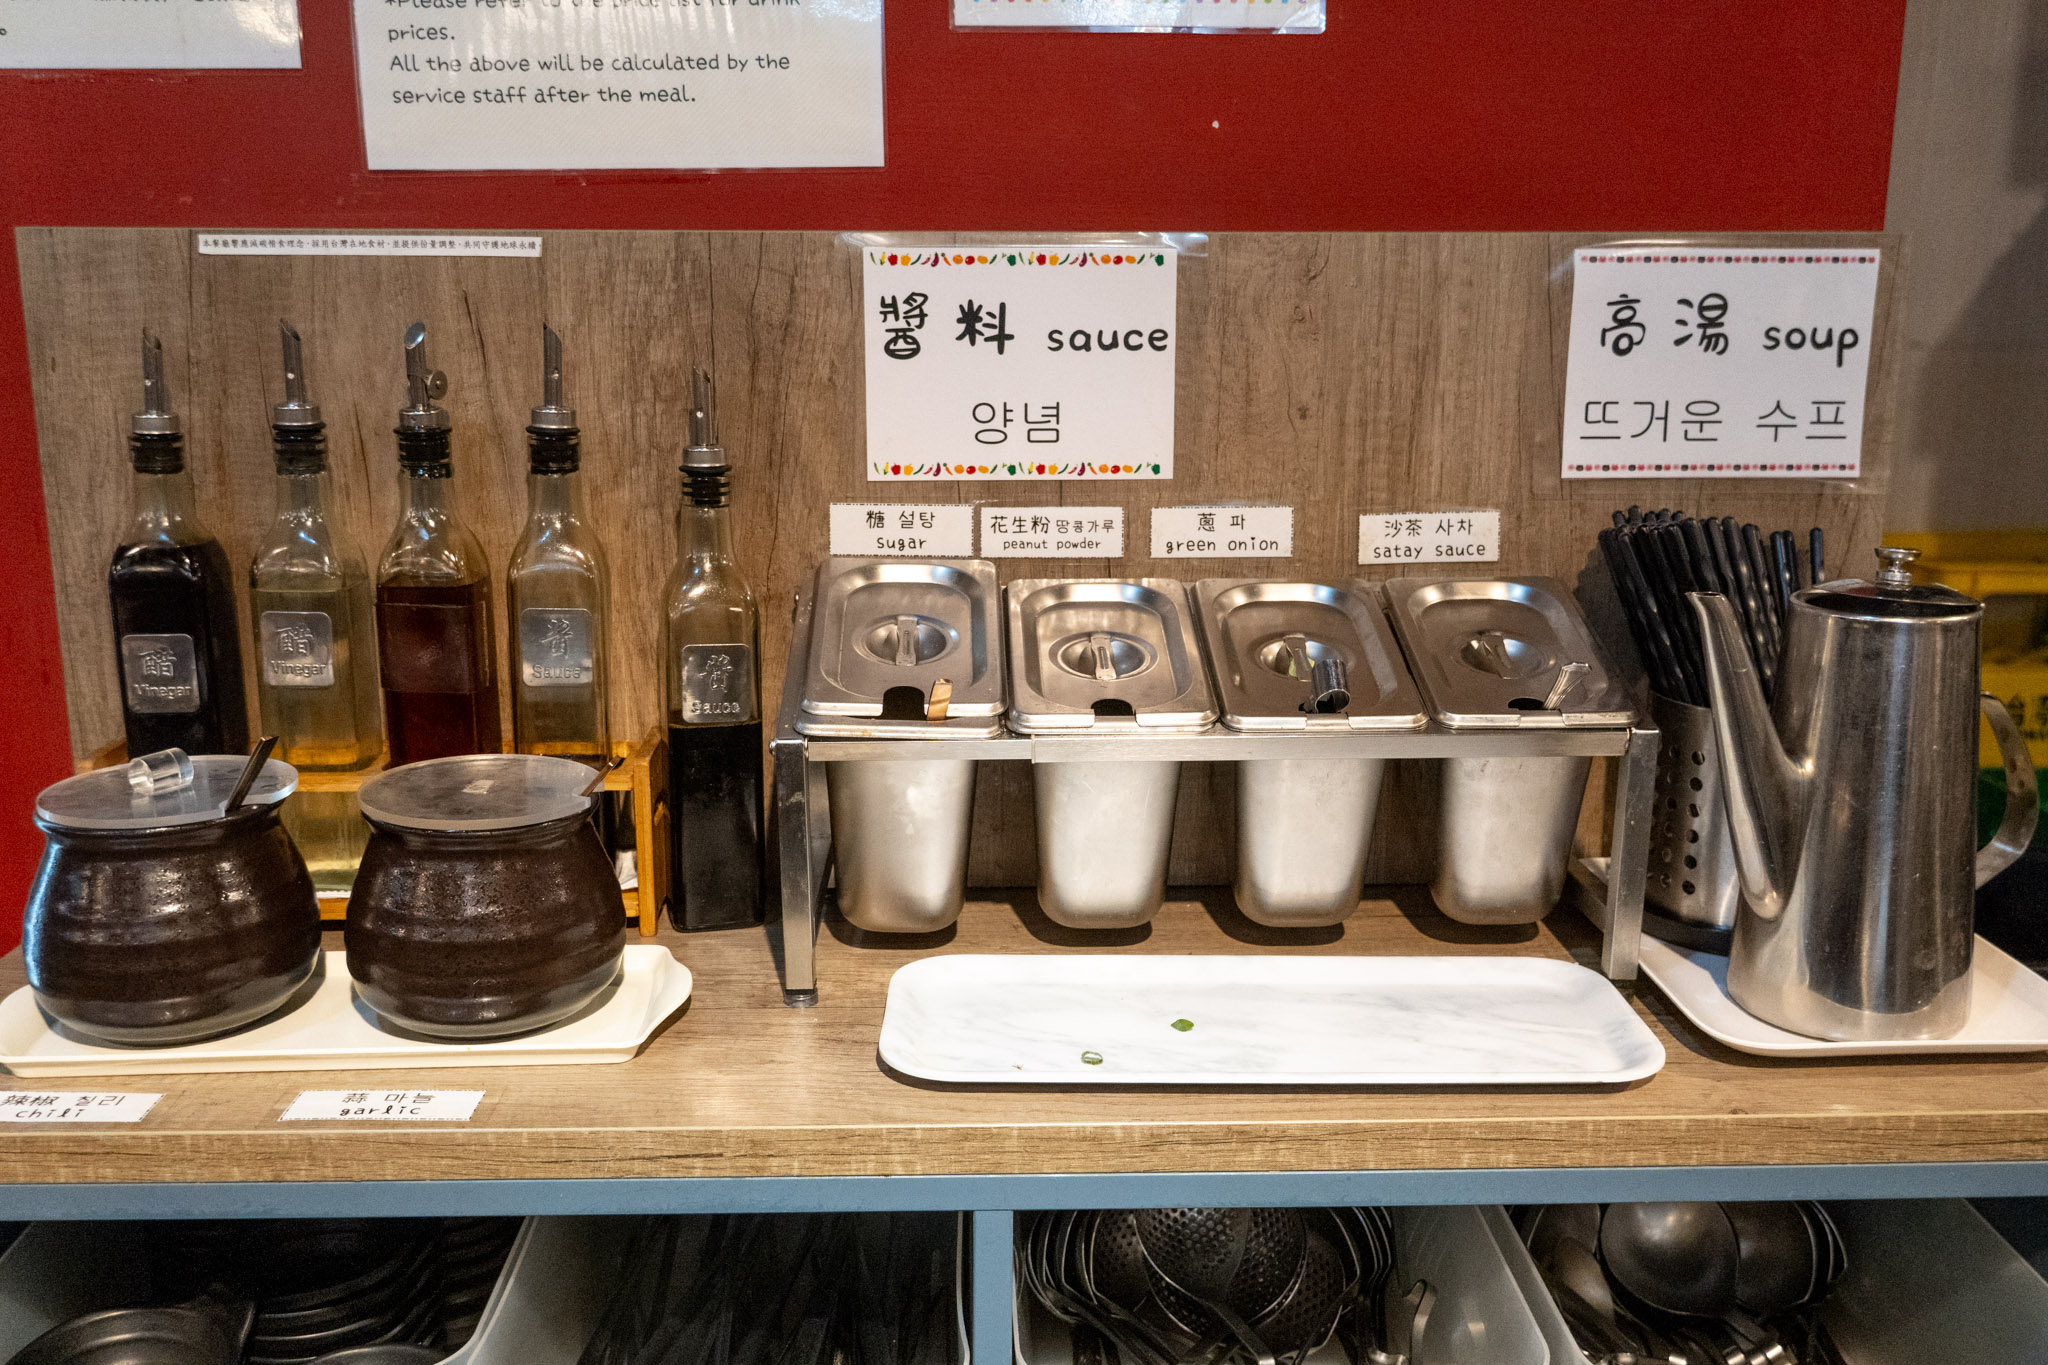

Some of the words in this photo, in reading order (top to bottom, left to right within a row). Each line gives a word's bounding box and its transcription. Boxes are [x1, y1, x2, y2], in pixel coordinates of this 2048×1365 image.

[388, 24, 455, 43] prices.
[390, 54, 420, 72] All
[426, 56, 461, 72] the
[470, 56, 530, 72] above
[538, 54, 574, 71] will
[581, 55, 604, 71] be
[612, 53, 719, 71] calculated
[728, 54, 748, 72] by
[755, 54, 790, 69] the
[393, 88, 465, 103] service
[473, 86, 526, 103] staff
[534, 86, 590, 103] after
[597, 87, 632, 102] the
[640, 84, 695, 102] meal.
[1047, 328, 1169, 352] sauce
[1762, 327, 1859, 368] soup
[972, 402, 1060, 444] 양념
[1580, 400, 1723, 442] 뜨거운
[1756, 400, 1847, 442] 수프
[866, 510, 885, 529] 糖
[899, 511, 936, 529] 설탕
[990, 515, 1050, 534] 花生粉
[1055, 519, 1115, 534] 땅콩가루
[1230, 514, 1246, 530] 파
[1385, 519, 1422, 538] 沙茶
[1435, 518, 1474, 536] 사차
[1004, 538, 1049, 551] peanut
[1057, 537, 1102, 550] powder
[1166, 539, 1217, 554] green
[1228, 537, 1279, 551] onion
[1374, 544, 1423, 560] satay
[1435, 543, 1486, 557] sauce
[271, 660, 327, 678] Vinegar
[531, 664, 582, 679] Sauce
[133, 684, 192, 699] Vinegar
[690, 701, 742, 715] Sauce
[384, 1093, 436, 1104] 마늘
[16, 1107, 85, 1119] chili
[339, 1104, 421, 1117] garlic
